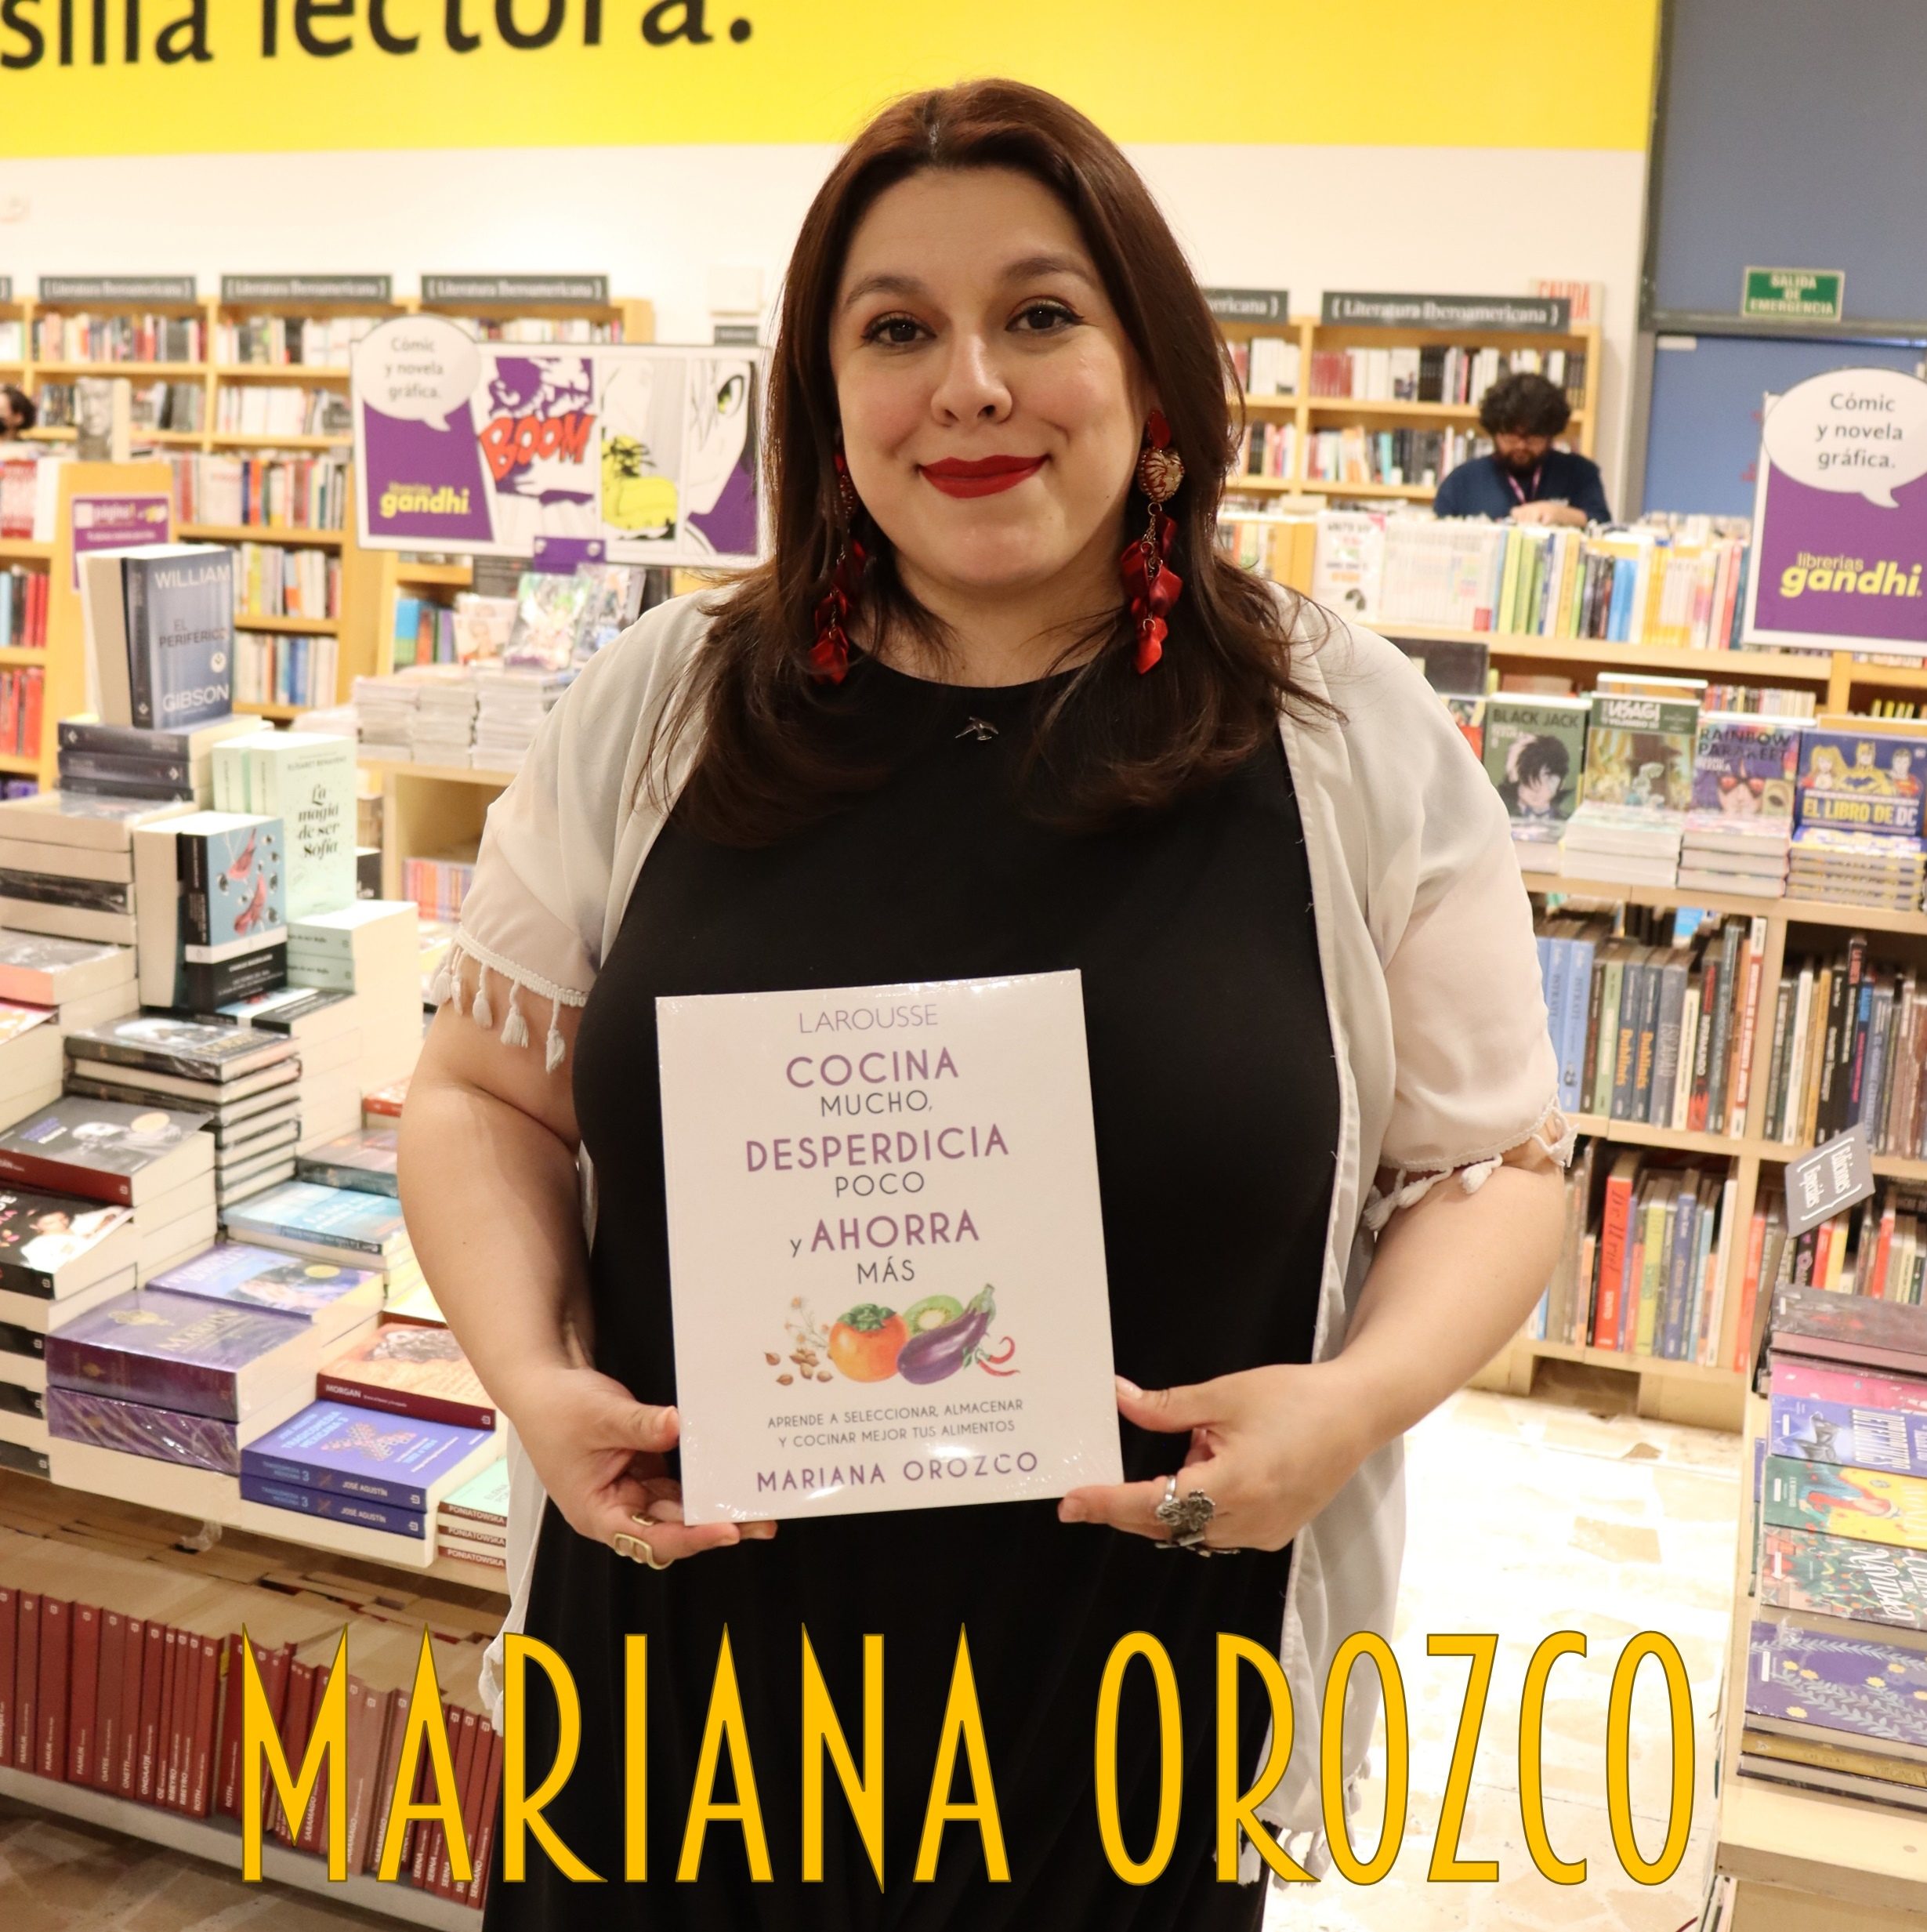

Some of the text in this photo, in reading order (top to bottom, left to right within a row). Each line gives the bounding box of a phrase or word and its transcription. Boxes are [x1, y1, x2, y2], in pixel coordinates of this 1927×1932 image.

[1771, 274, 1817, 288] SALIDA
[1344, 303, 1548, 324] Literatura Iberoamericana
[1750, 299, 1834, 314] EMERGENCIA
[397, 363, 444, 375] novela
[1830, 392, 1896, 411] Cómic
[1816, 422, 1903, 442] y novela
[479, 414, 596, 482] BOOM
[1818, 448, 1896, 470] gráfica.
[155, 564, 230, 589] WILLIAM
[163, 683, 230, 713] GIBSON
[1493, 708, 1580, 728] BLACK JACK
[1699, 727, 1791, 747] RAINBOW
[298, 803, 339, 822] magia
[1802, 797, 1918, 827] EL LIBRO DE DC
[317, 823, 340, 836] ser
[799, 1003, 938, 1034] LAROUSSE
[786, 1046, 958, 1089] COCINA
[820, 1089, 933, 1117] MUCHO,
[746, 1123, 1009, 1173] DESPERDICIA
[835, 1171, 925, 1198] POCO
[810, 1209, 980, 1252] AHORRA
[857, 1256, 916, 1285] MÁS
[325, 1383, 362, 1399] MORGAN
[767, 1412, 825, 1430] APRENDE
[830, 1410, 839, 1424] A
[944, 1398, 1024, 1416] ALMACENAR
[778, 1419, 1016, 1448] Y COCINAR MEJOR TUS ALIMENTOS
[302, 1470, 310, 1482] 3
[757, 1452, 1039, 1493] MARIANA OROZCO
[342, 1481, 389, 1497] JOSÉ AGUSTÍN
[301, 1496, 310, 1508] 3
[448, 1504, 505, 1524] PONIATOWSKA
[340, 1506, 387, 1524] JOSÉ AGUSTÍN
[447, 1528, 505, 1546] PONIATOWSKA
[447, 1548, 505, 1568] PONIATOWSKA
[76, 1746, 85, 1775] PAMUK
[101, 1757, 110, 1782] OATES
[121, 1760, 130, 1789] ONETTI
[141, 1754, 152, 1795] ONDAATJE
[168, 1768, 177, 1802] RIBEYRO
[179, 1772, 189, 1806] RIBEYRO
[225, 1785, 234, 1808] ROTH
[304, 1796, 317, 1842] SARAMAGO
[413, 1852, 424, 1879] SERNA
[427, 1856, 437, 1883] SERNA
